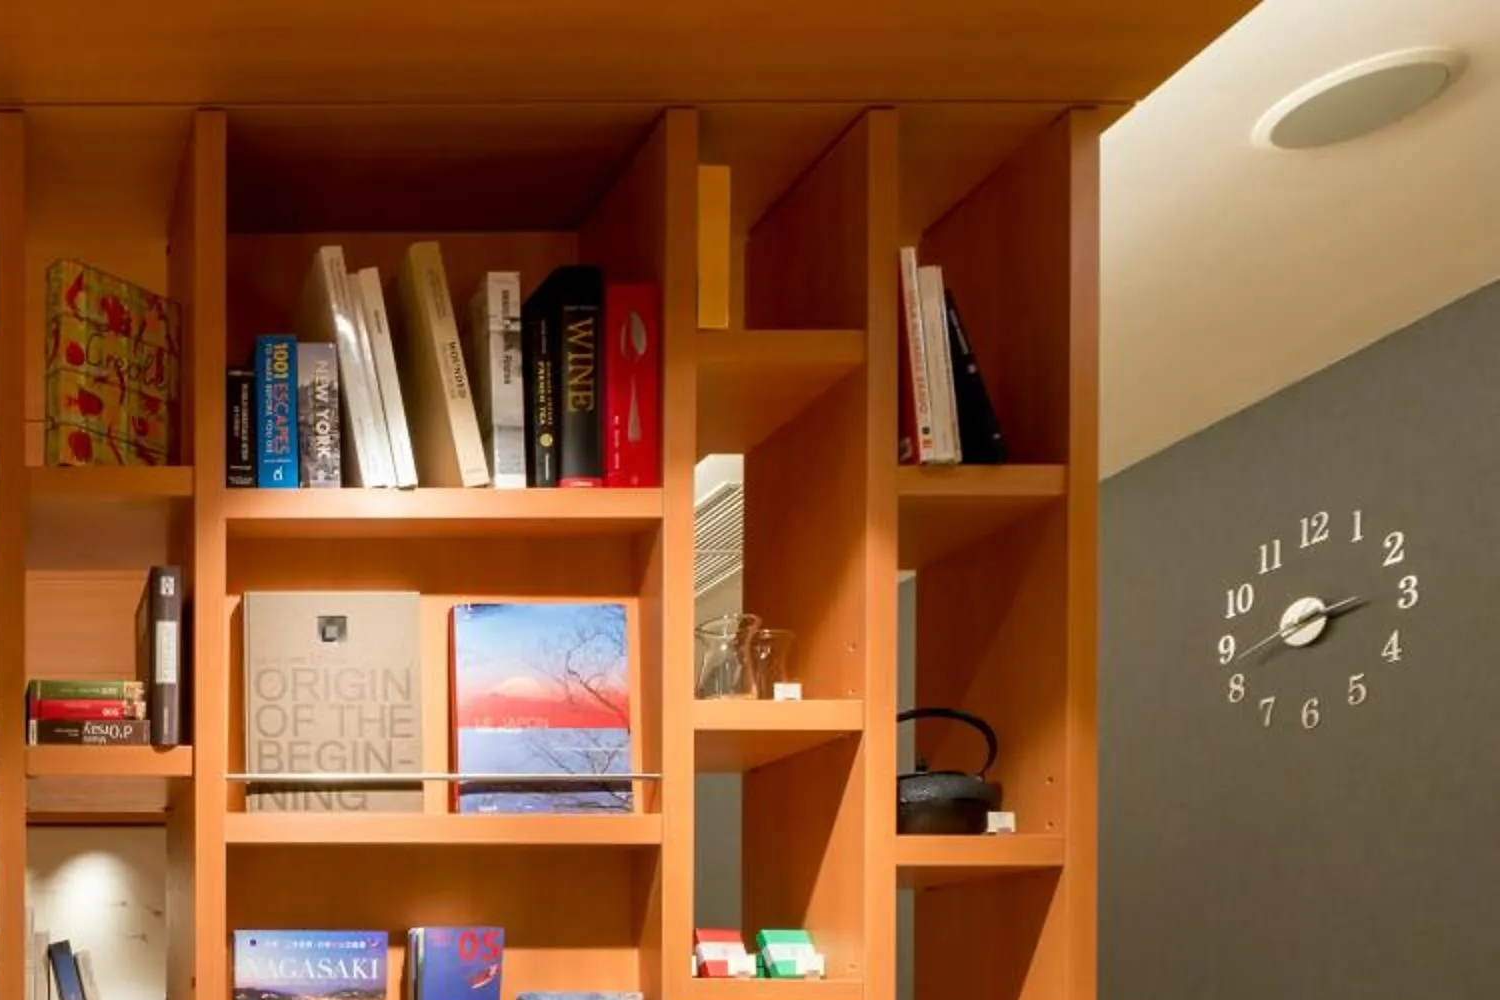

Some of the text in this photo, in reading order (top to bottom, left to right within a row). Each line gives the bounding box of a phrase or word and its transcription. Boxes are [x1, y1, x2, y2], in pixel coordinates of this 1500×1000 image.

[567, 317, 596, 413] WINE
[265, 384, 273, 417] BEFORE
[272, 343, 289, 454] 1001 ESCAPES
[315, 359, 330, 457] NEW YORK
[265, 419, 273, 438] YOU
[1299, 511, 1330, 548] 12
[1351, 509, 1364, 543] 1
[1258, 539, 1283, 575] 11
[1382, 531, 1405, 567] 2
[1224, 583, 1254, 620] 10
[1397, 575, 1419, 609] 3
[1218, 634, 1236, 665] 9
[1381, 629, 1403, 663] 4
[253, 667, 411, 702] ORIGIN
[1228, 673, 1246, 703] 8
[1347, 672, 1367, 705] 5
[255, 703, 414, 739] OF THE
[1259, 696, 1276, 727] 7
[1301, 697, 1320, 729] 6
[83, 721, 133, 740] d'Orsay
[257, 740, 414, 774] BEGIN-
[457, 930, 501, 962] 05
[246, 957, 379, 980] NAGASAKI
